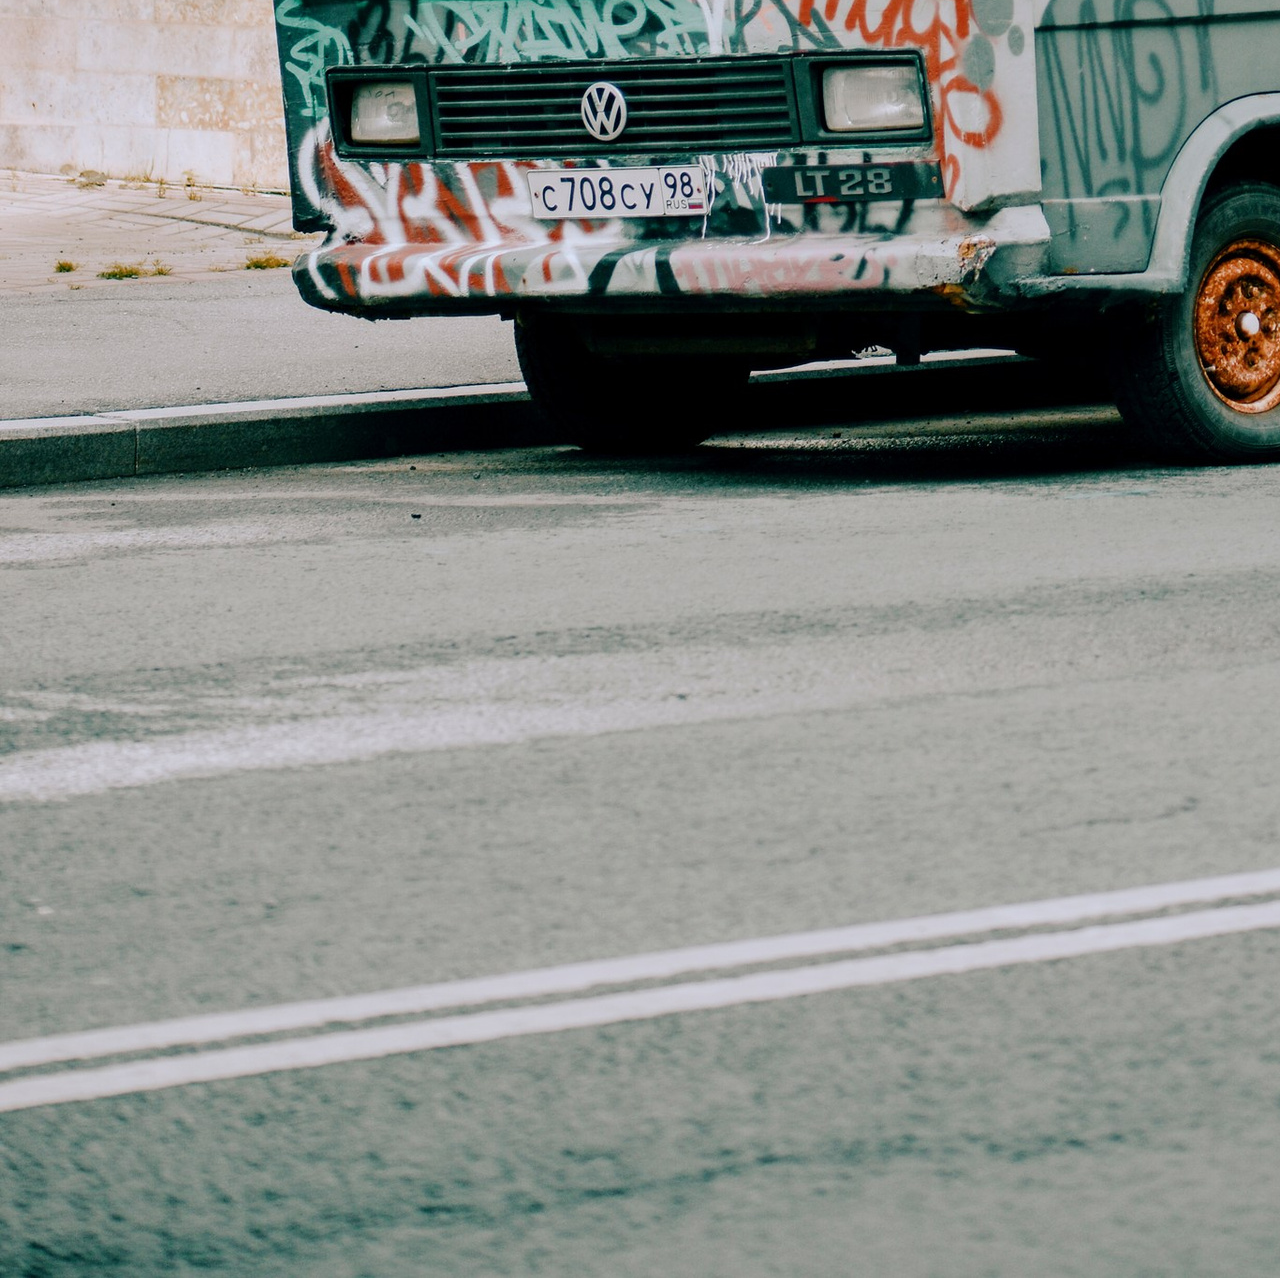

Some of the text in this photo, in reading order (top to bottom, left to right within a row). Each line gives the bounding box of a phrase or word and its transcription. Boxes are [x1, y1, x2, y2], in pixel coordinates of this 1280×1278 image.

[663, 171, 694, 199] 98
[794, 168, 893, 197] LT 28
[665, 199, 688, 210] RUS
